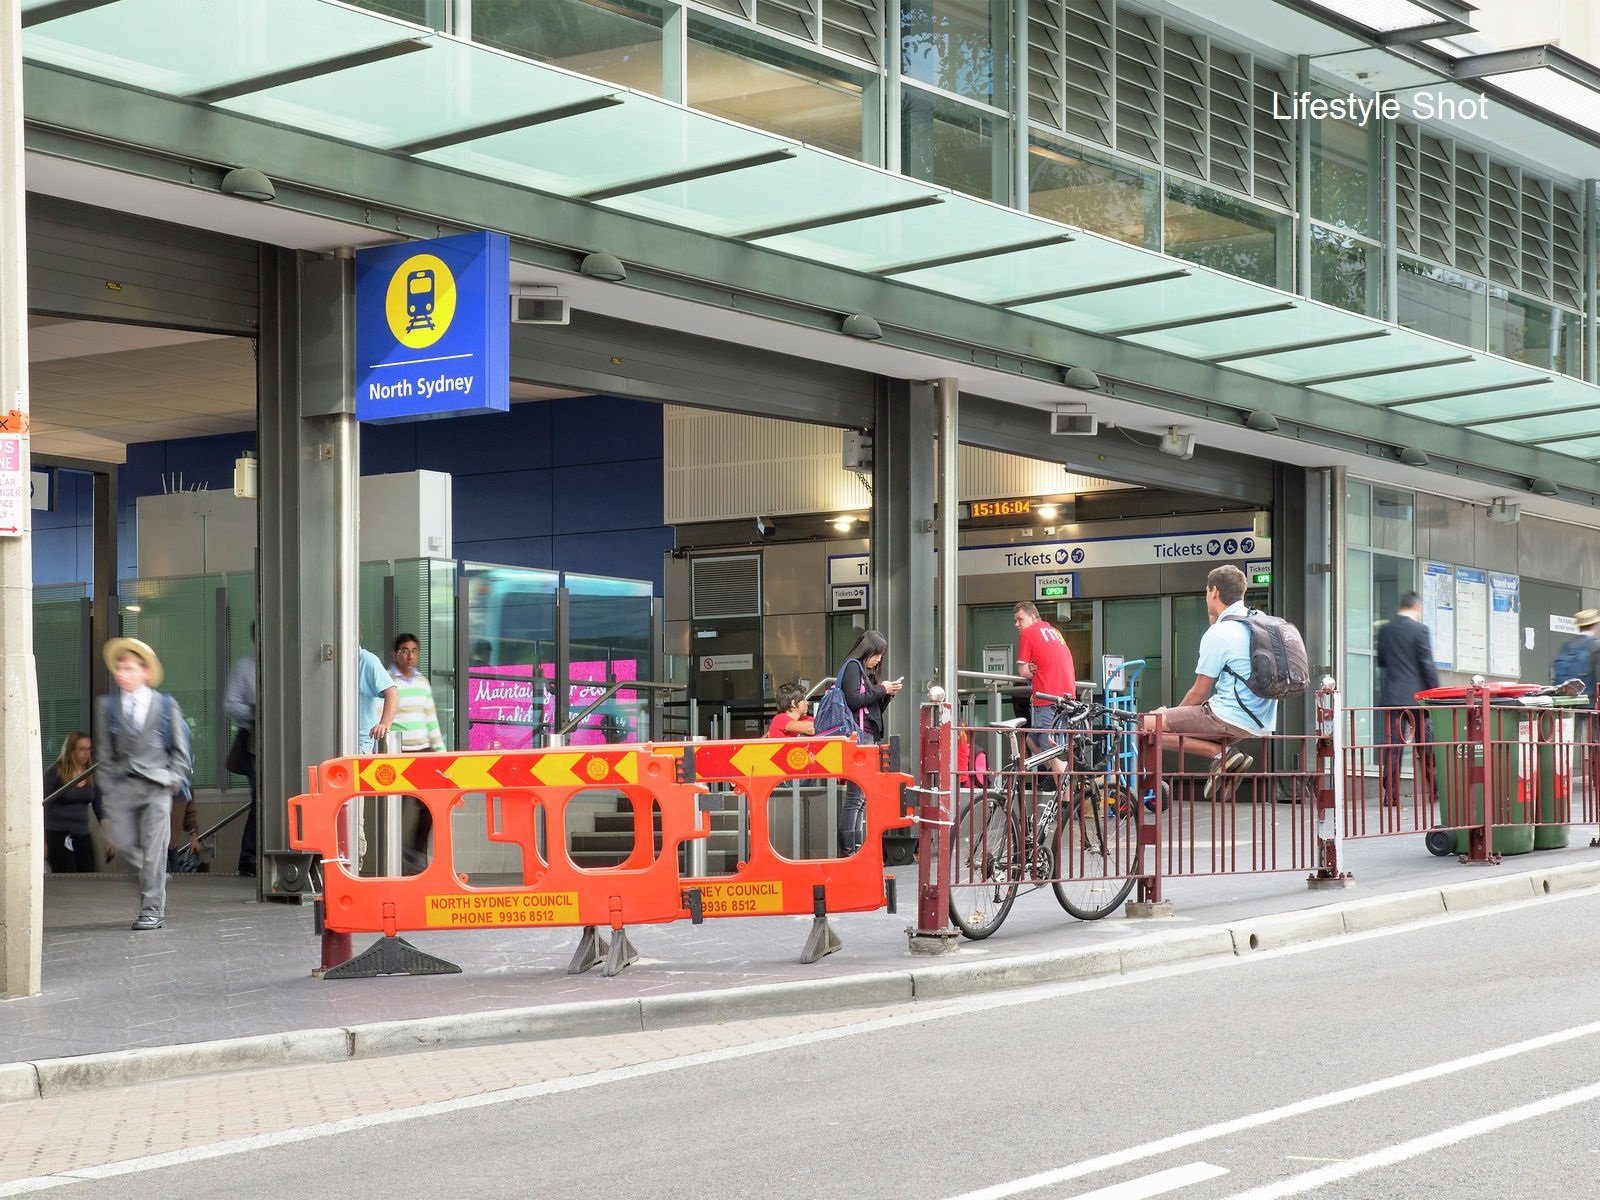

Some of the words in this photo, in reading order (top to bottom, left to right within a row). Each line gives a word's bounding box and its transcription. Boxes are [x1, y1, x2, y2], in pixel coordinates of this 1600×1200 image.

[369, 378, 413, 401] North
[417, 374, 474, 399] Sydney
[0, 440, 15, 454] S
[973, 501, 1030, 516] 15:16:04
[1153, 543, 1203, 558] Tickets
[1005, 552, 1052, 567] Tickets
[1046, 587, 1064, 595] OPEN
[475, 680, 534, 702] Maintai
[727, 884, 778, 897] COUNCIL
[431, 898, 471, 909] NORTH
[474, 897, 519, 908] SYDNEY
[523, 895, 573, 907] COUNCIL
[732, 900, 756, 911] 8512
[452, 912, 493, 923] PHONE
[499, 911, 526, 922] 9936
[529, 911, 554, 922] 8512
